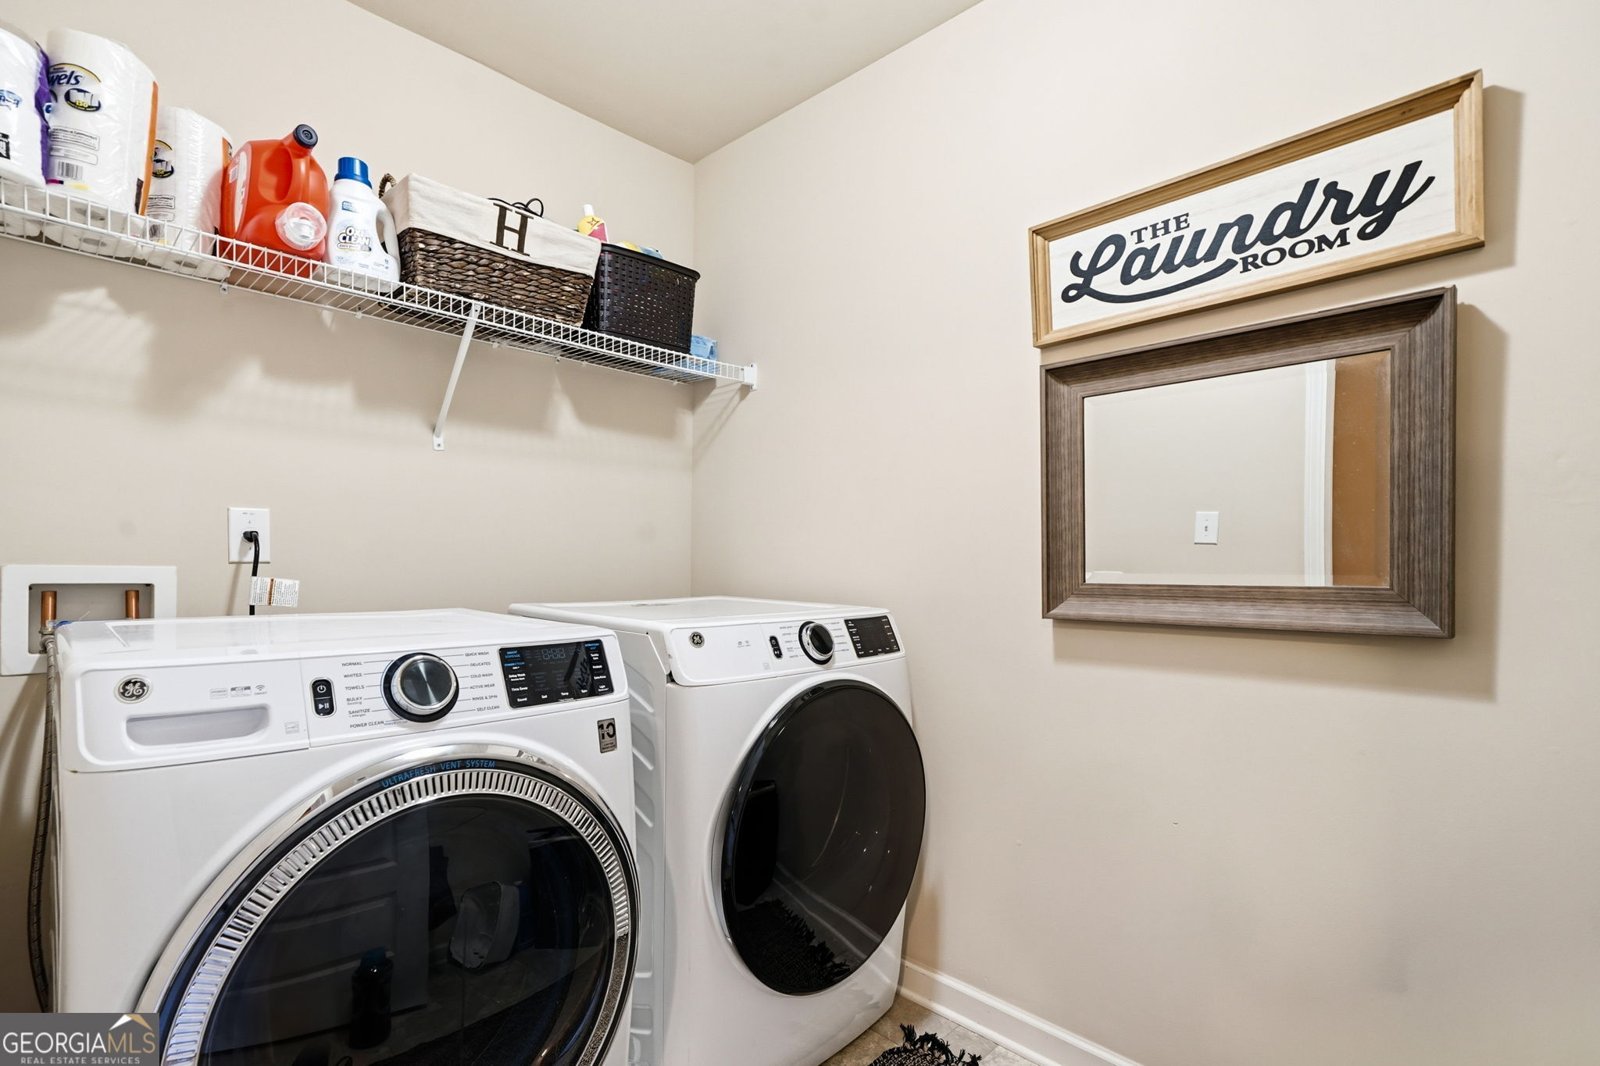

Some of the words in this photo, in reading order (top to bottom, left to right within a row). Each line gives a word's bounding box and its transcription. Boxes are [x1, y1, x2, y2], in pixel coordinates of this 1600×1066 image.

[1060, 159, 1436, 304] Laundry
[1130, 212, 1191, 246] THE
[1238, 227, 1351, 275] ROOM
[120, 678, 148, 699] GE
[597, 721, 616, 740] 10
[381, 765, 436, 788] ULTRAFRESH
[440, 760, 461, 770] VENT
[465, 760, 496, 768] SYSTEM
